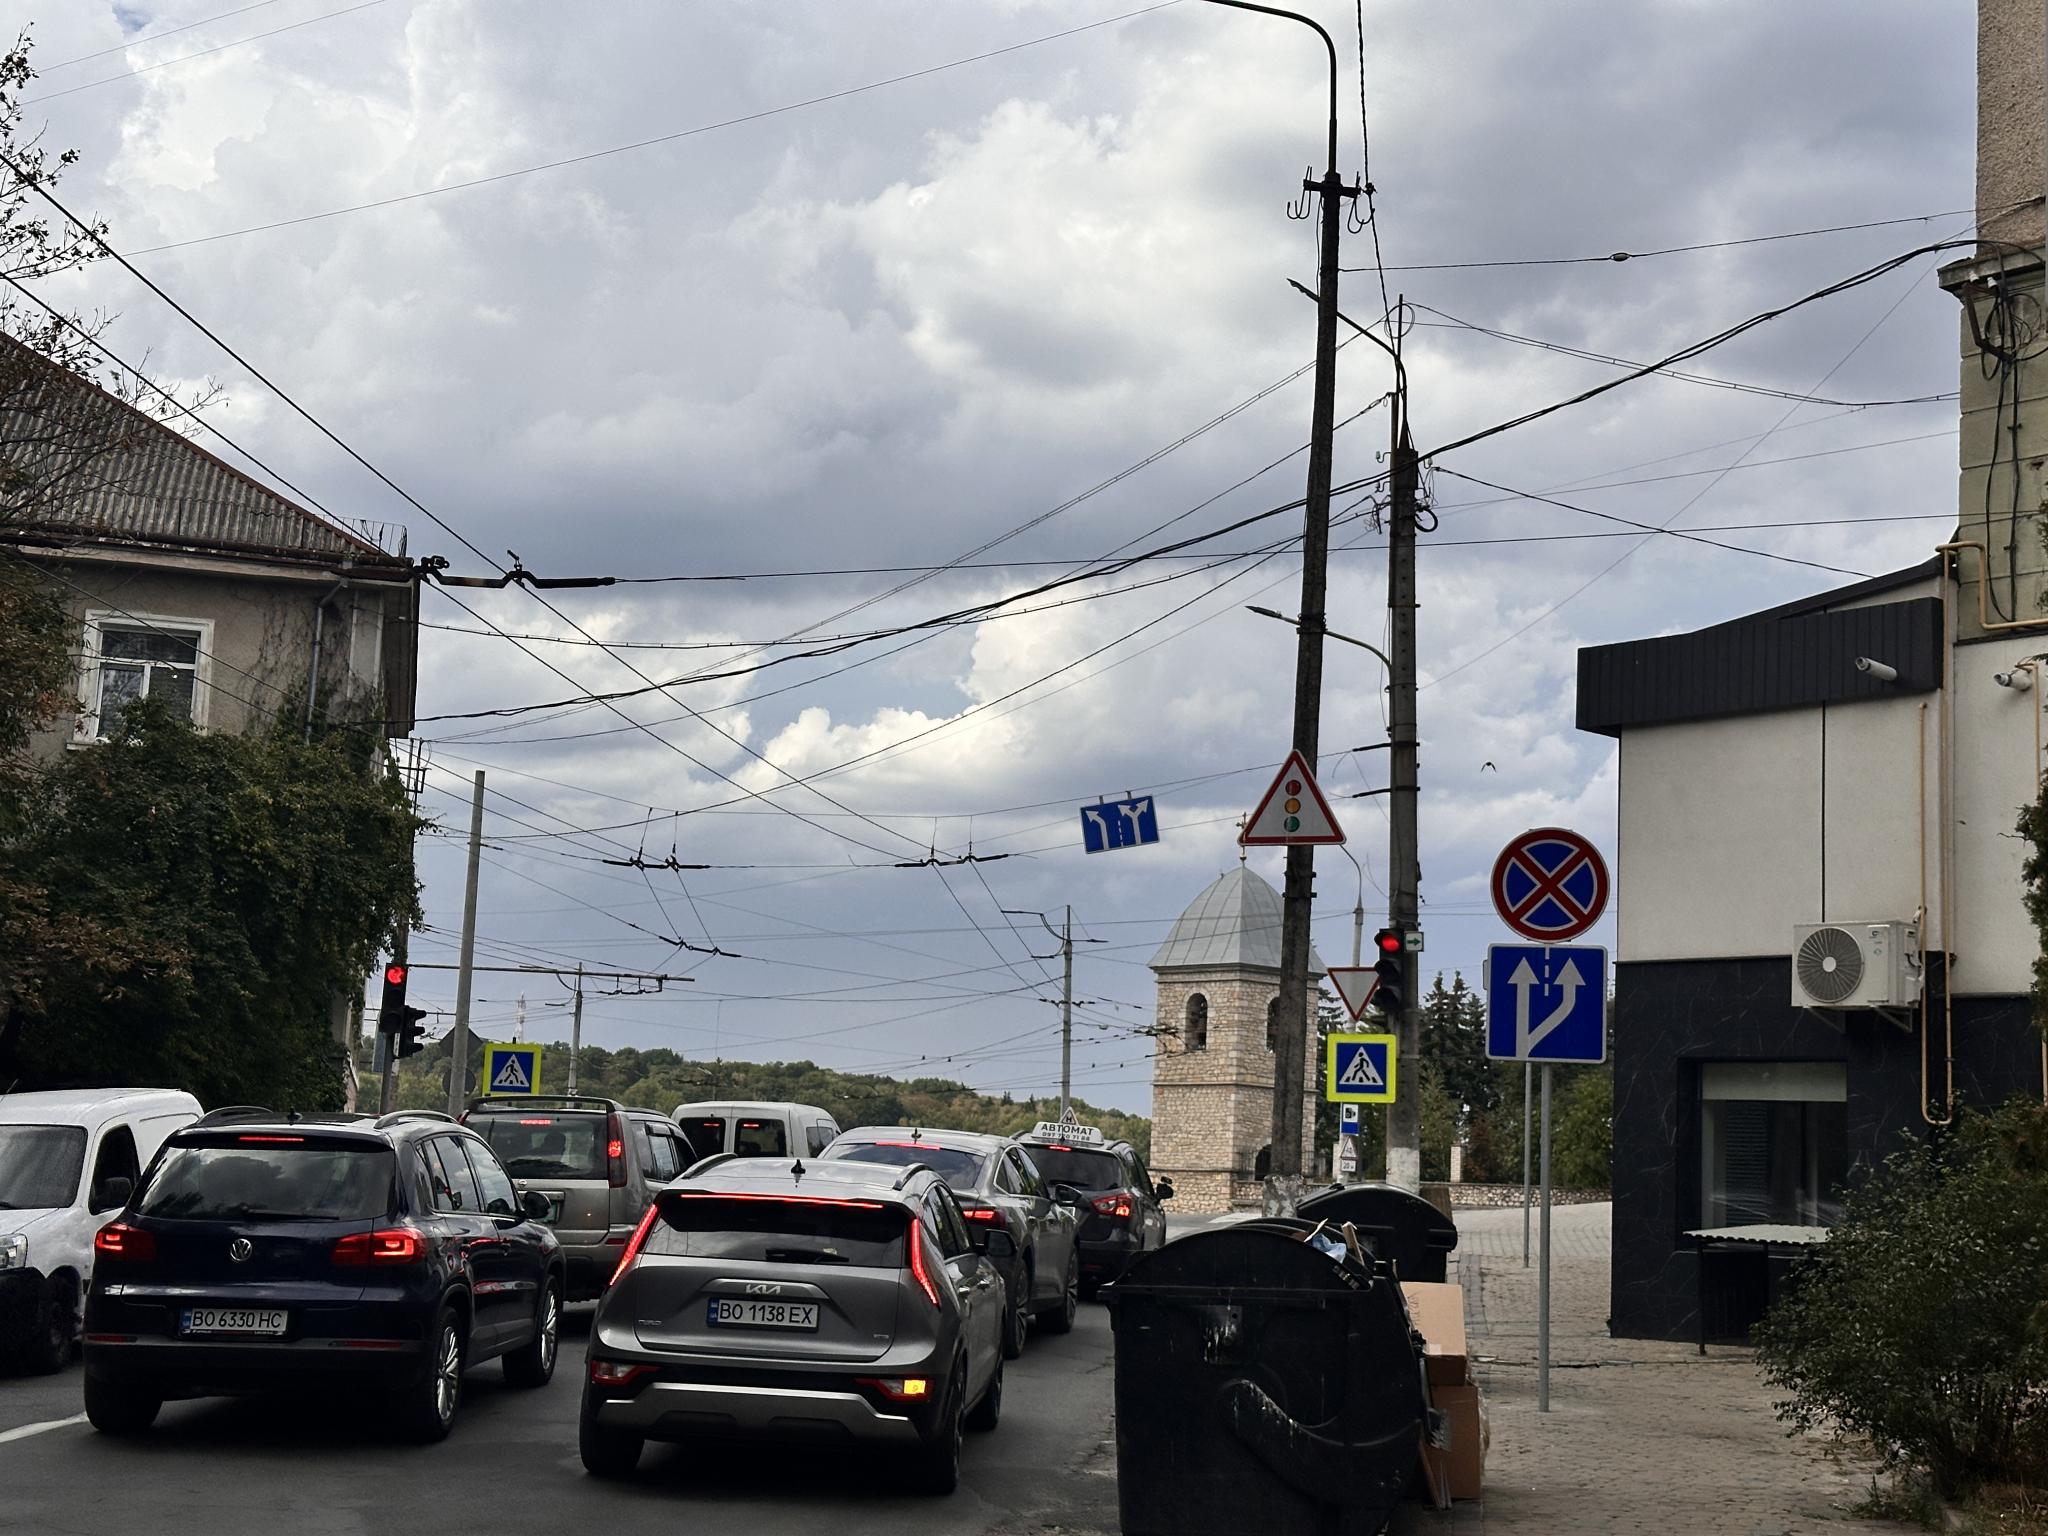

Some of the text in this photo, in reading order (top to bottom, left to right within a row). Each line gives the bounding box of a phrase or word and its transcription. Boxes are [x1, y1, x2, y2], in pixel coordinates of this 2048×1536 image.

[1041, 1123, 1094, 1136] АВТОМАТ
[192, 1311, 215, 1327] BO
[218, 1311, 255, 1328] 6330
[258, 1312, 282, 1328] HC
[720, 1302, 813, 1325] BO 1138 EX
